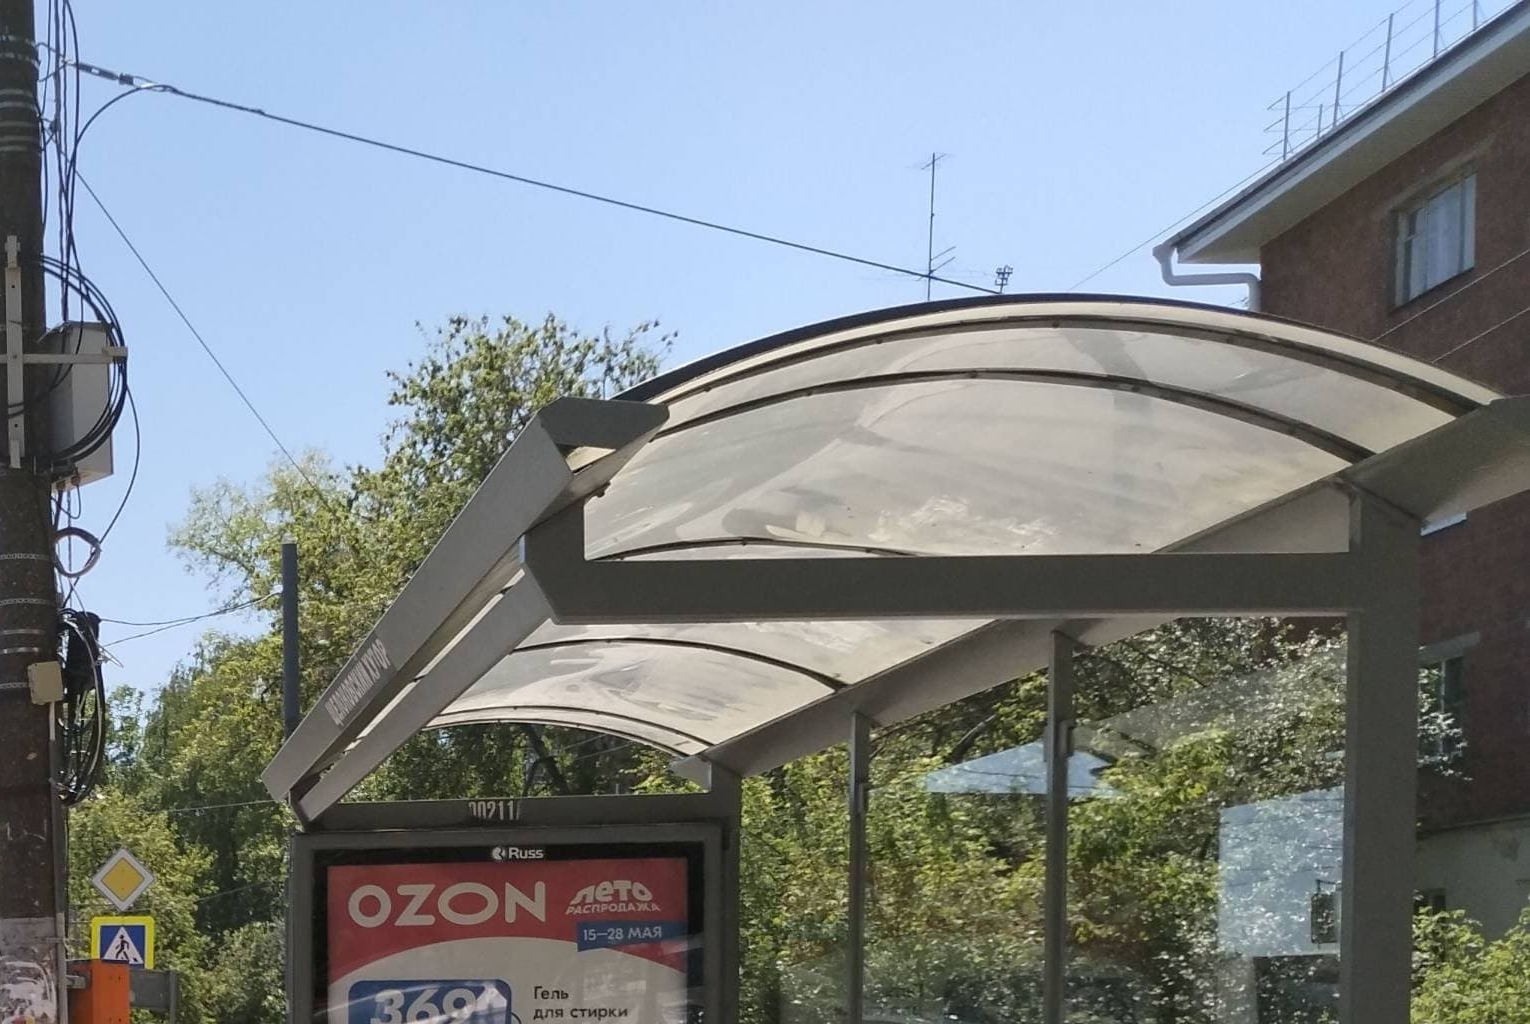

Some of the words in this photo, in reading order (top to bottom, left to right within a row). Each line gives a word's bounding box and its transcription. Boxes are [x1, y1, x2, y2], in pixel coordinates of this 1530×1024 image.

[508, 846, 544, 860] Russ
[347, 881, 546, 928] OZON
[565, 902, 661, 916] РАСПРОДАЖА
[628, 925, 662, 940] МАЯ
[533, 986, 569, 1001] Гель
[533, 1008, 565, 1020] для
[570, 1008, 629, 1020] стирки
